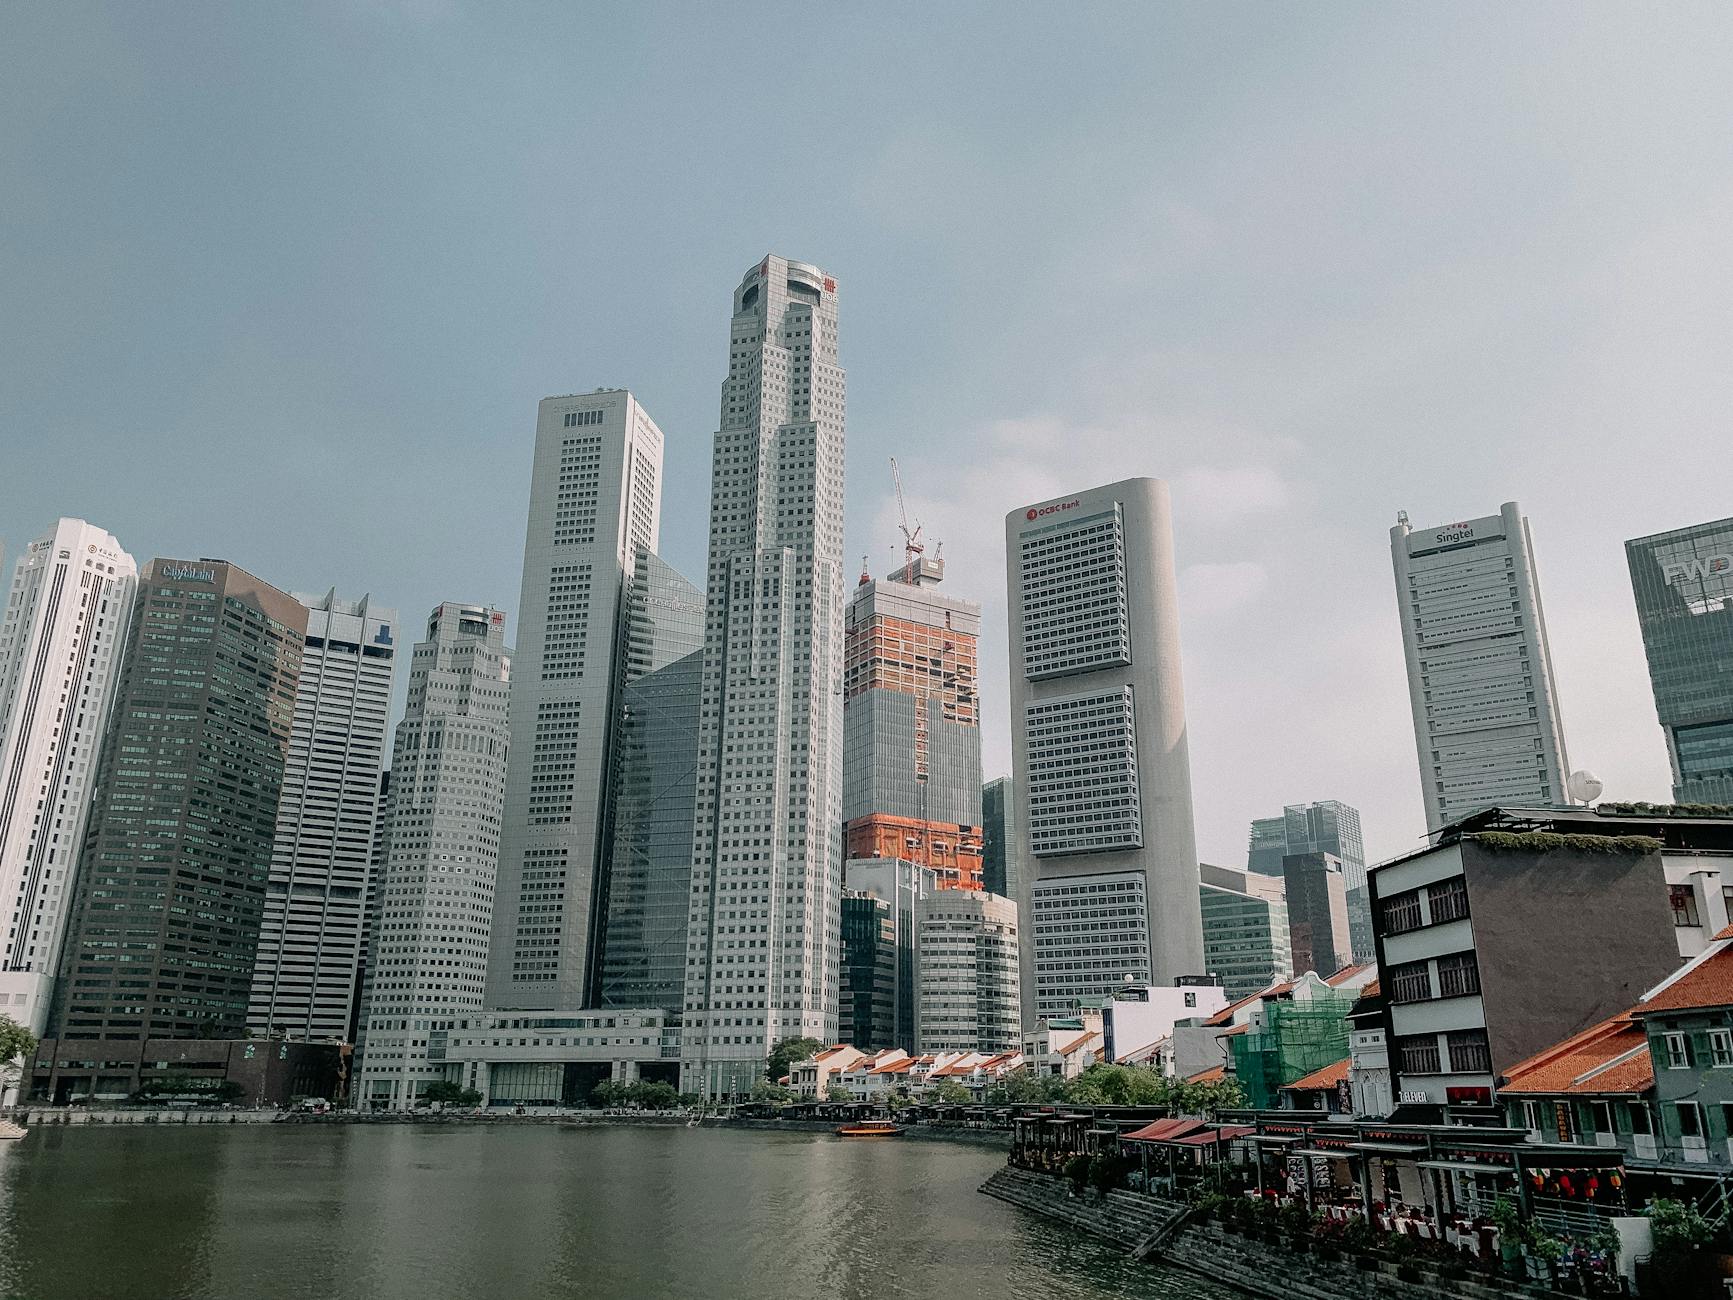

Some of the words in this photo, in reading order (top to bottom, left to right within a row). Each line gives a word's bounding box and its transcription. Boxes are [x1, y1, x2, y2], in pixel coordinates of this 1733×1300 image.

[1039, 504, 1061, 516] OCBC
[1061, 499, 1080, 510] Bank
[1436, 528, 1474, 543] Singtel
[1662, 554, 1733, 586] FWD
